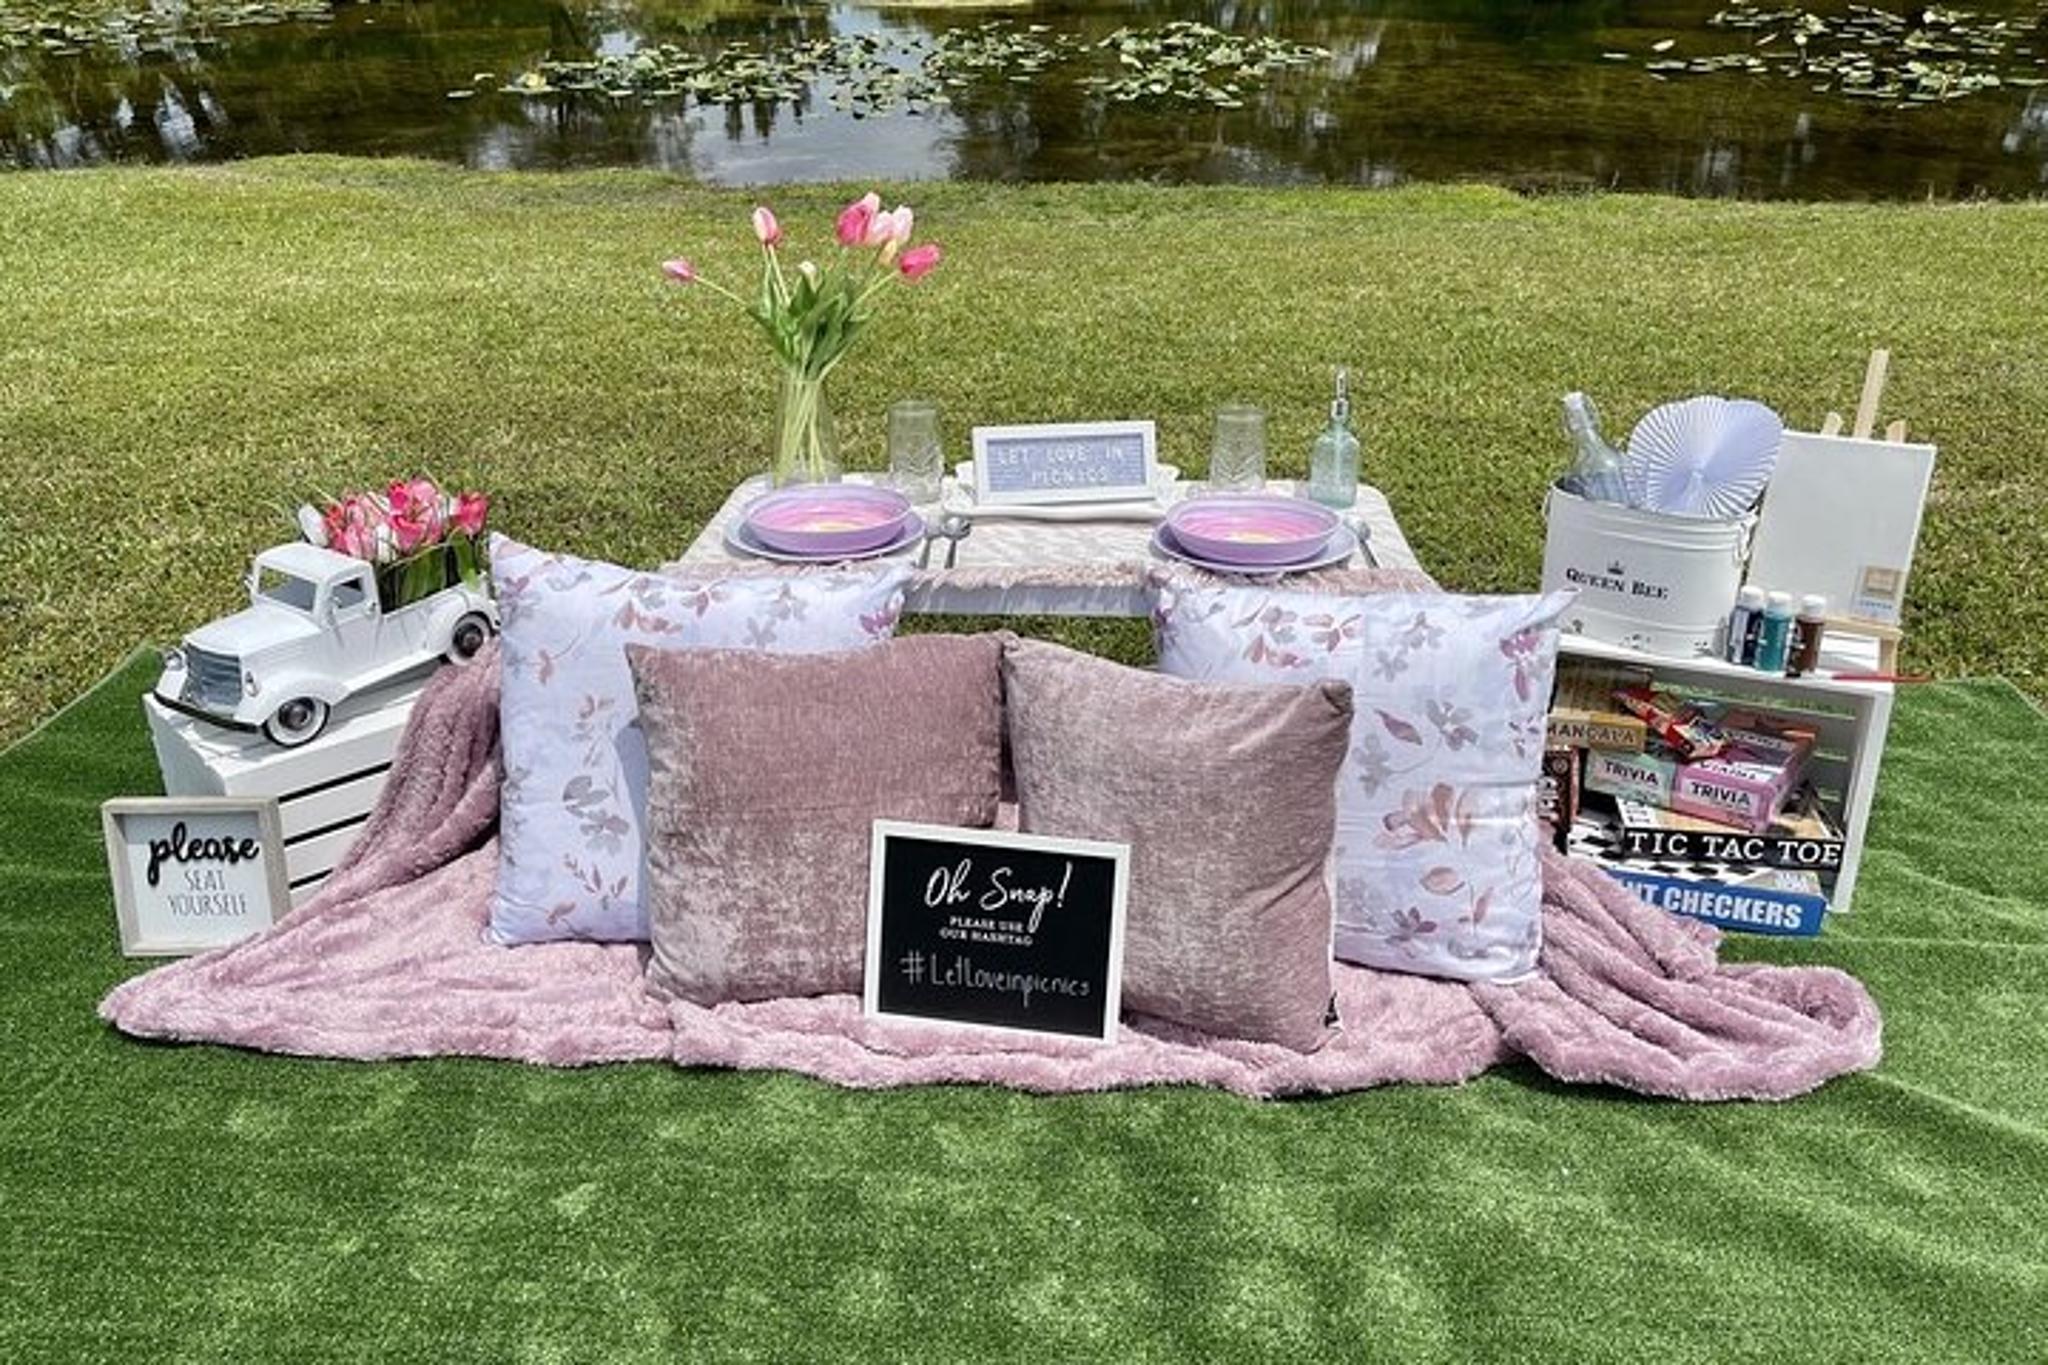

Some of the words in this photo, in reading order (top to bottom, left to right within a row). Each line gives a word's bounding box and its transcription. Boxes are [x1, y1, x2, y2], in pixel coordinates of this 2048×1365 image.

[999, 448, 1030, 465] LET
[1048, 445, 1089, 464] LOVE
[1105, 444, 1124, 461] IN
[1566, 568, 1625, 593] QUEEN
[1631, 580, 1669, 600] BEE
[1604, 759, 1659, 786] TRIVIA
[1690, 781, 1751, 806] TRIVIA
[147, 821, 260, 887] please
[1628, 831, 1689, 856] TIC
[1703, 836, 1765, 861] TAC
[1777, 840, 1842, 865] TOE
[183, 868, 227, 892] SEAT
[167, 893, 247, 918] YOURSELF
[924, 857, 973, 908] Oh
[979, 860, 1074, 934] Snap!
[1663, 885, 1803, 930] CHECKERS
[939, 926, 968, 941] OUR
[971, 930, 1034, 947] HASHTAG
[949, 915, 996, 931] PLEASE
[998, 920, 1025, 934] USE
